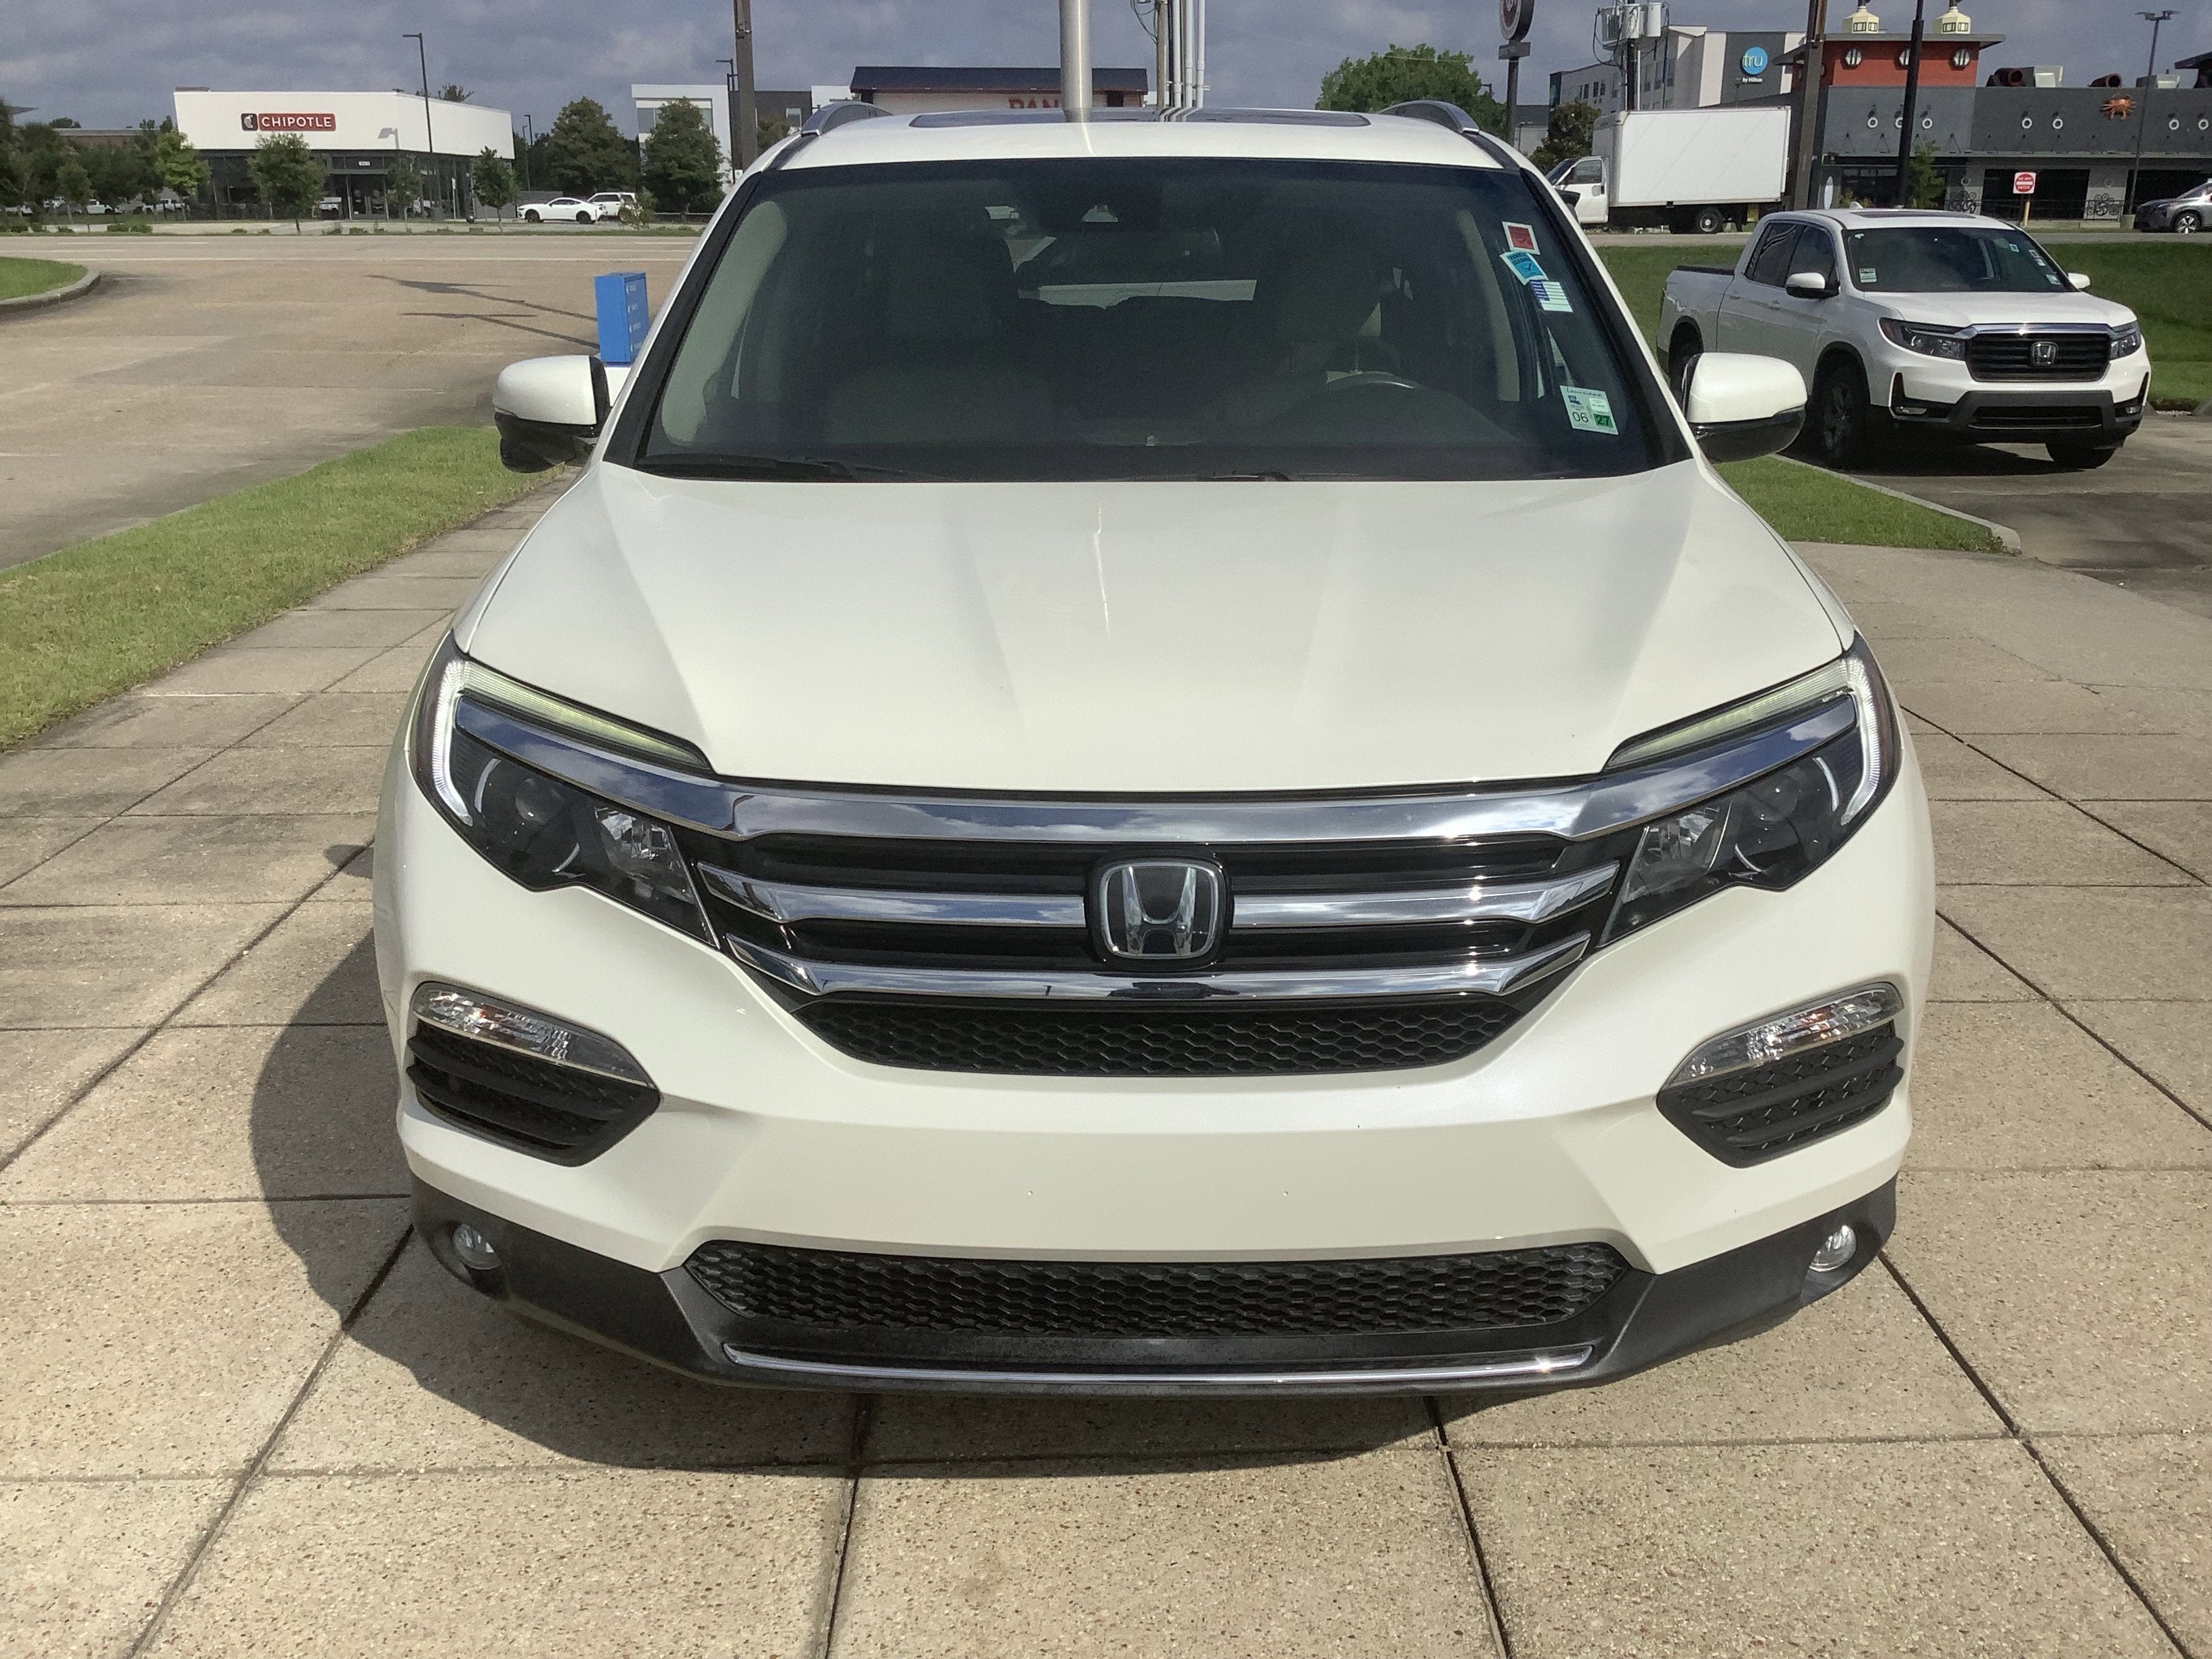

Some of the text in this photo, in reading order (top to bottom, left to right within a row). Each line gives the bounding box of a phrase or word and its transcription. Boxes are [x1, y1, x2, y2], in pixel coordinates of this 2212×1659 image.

[1743, 54, 1763, 67] tru
[261, 117, 332, 127] CHIPOTLE
[1572, 411, 1589, 422] 06
[1595, 415, 1610, 426] 27
